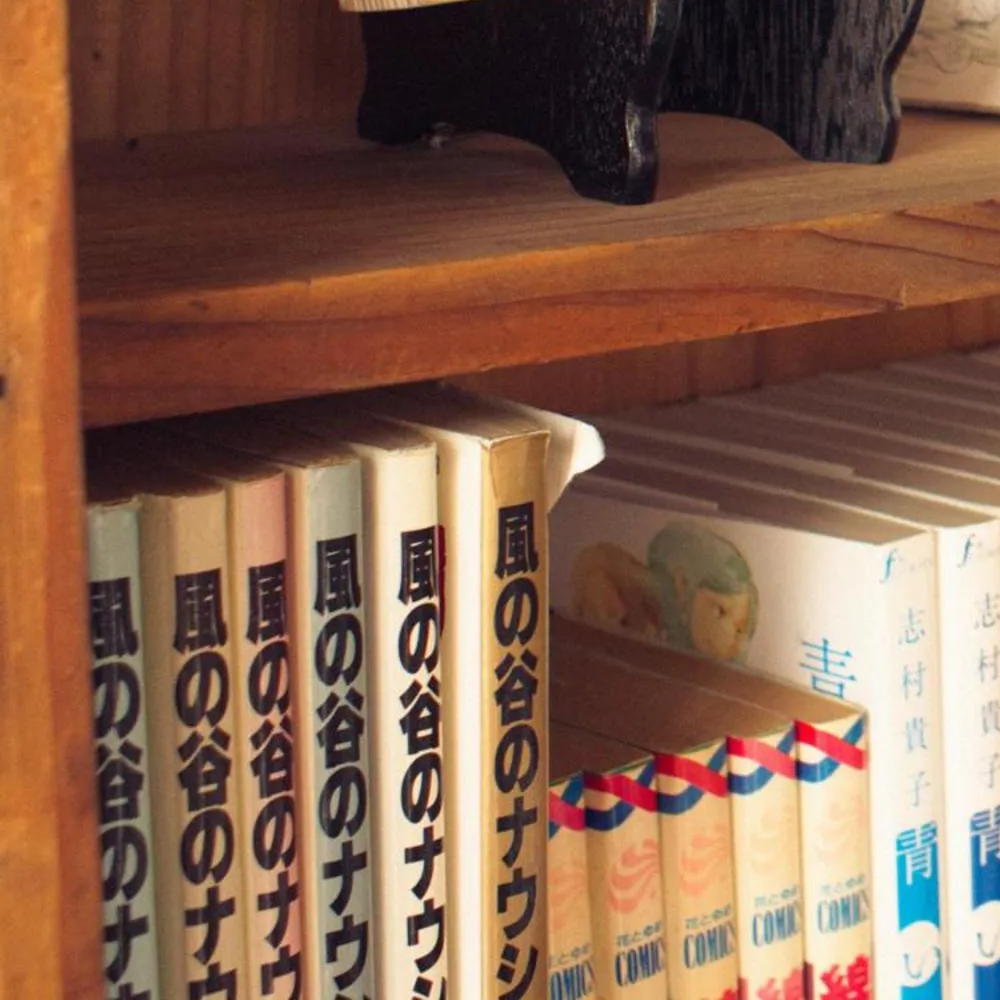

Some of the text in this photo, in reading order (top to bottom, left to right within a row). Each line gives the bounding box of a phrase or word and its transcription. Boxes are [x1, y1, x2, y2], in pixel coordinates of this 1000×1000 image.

[89, 577, 149, 1000] 風の谷のナ
[313, 534, 369, 1000] 風の谷のナウ
[493, 502, 540, 1000] 風の谷のナウシ
